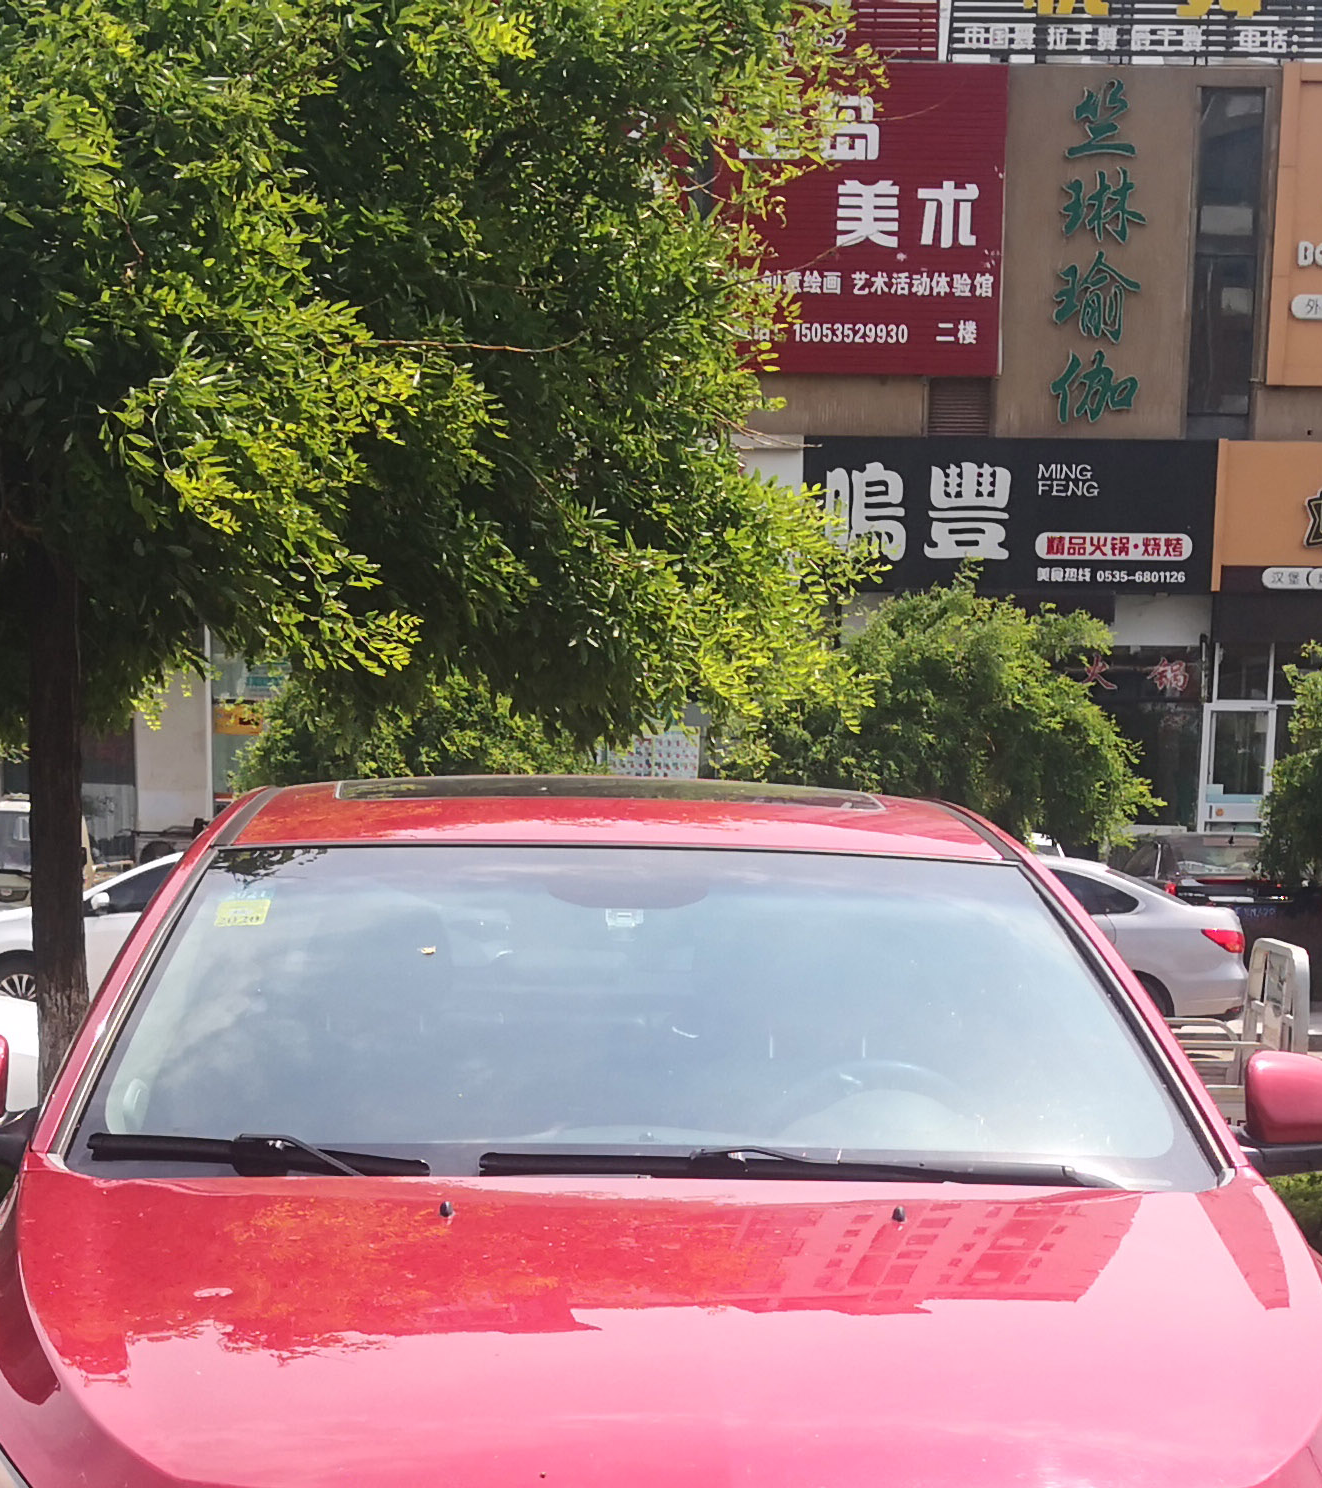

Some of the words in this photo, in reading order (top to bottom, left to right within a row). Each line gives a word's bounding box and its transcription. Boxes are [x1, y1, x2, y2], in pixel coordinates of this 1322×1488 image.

[836, 178, 979, 249] 美术
[851, 271, 994, 298] 艺术活动体验馆
[794, 322, 908, 344] 15053529930
[935, 319, 978, 345] 二楼
[1037, 463, 1093, 480] MING
[1037, 480, 1100, 497] FENG
[1045, 535, 1184, 558] 精品火锅·烧烤
[1096, 570, 1186, 583] 0535-6801126
[1082, 652, 1190, 692] 火锅
